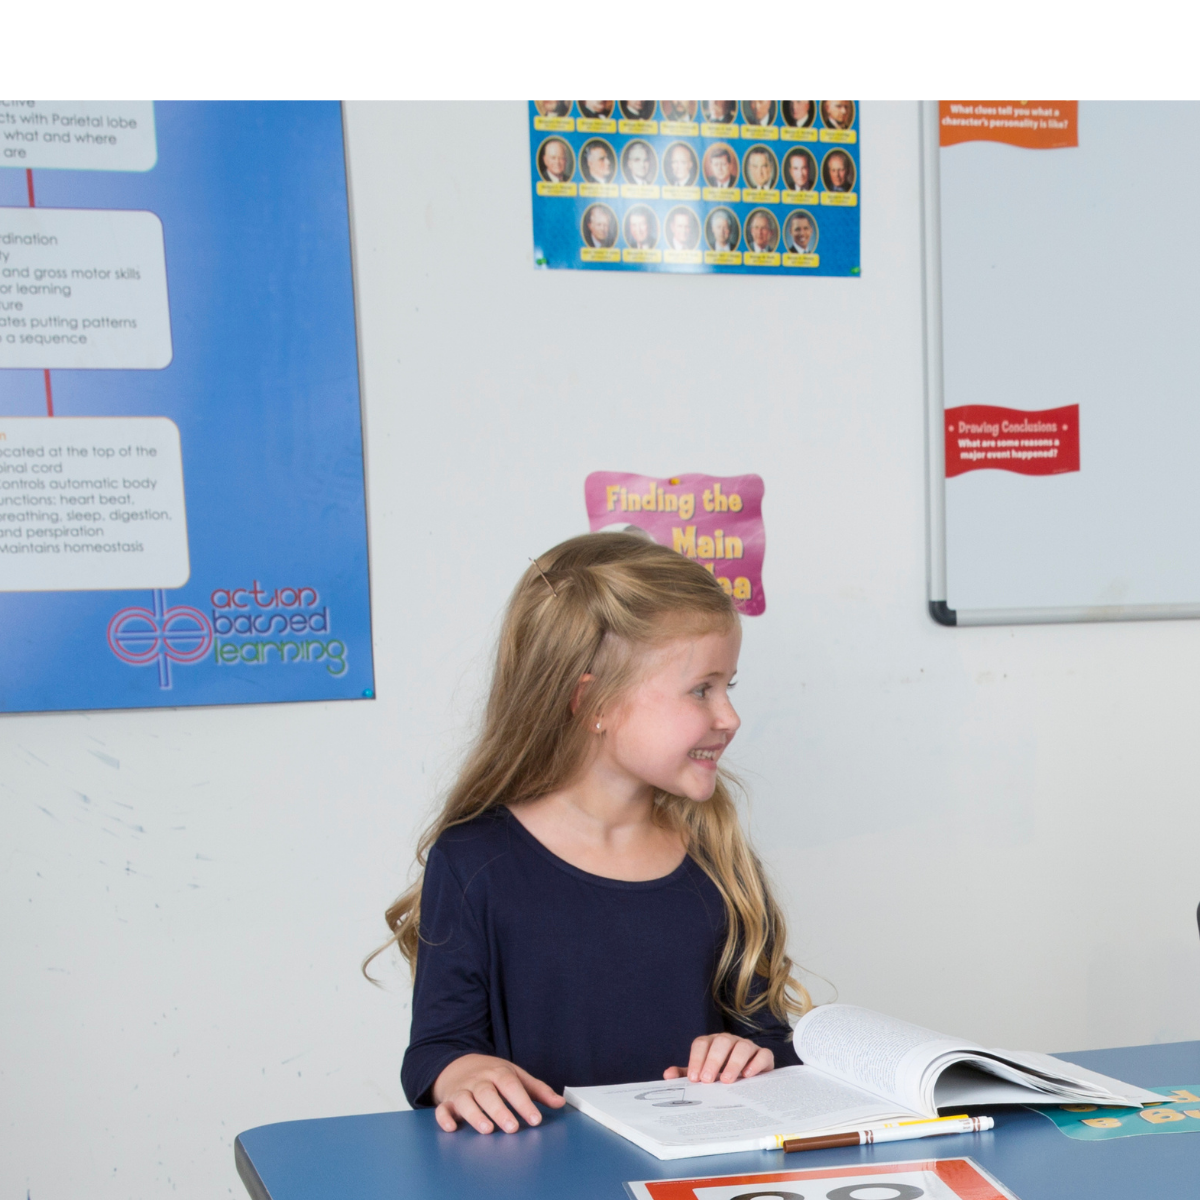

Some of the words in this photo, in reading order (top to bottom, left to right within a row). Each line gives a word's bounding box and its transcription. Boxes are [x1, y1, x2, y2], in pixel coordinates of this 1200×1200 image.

[950, 104, 973, 114] What
[1013, 107, 1030, 118] you
[1031, 107, 1053, 116] what
[20, 112, 48, 125] with
[52, 113, 104, 127] Parietal
[107, 116, 138, 129] lobe
[989, 118, 1038, 131] personality
[3, 130, 39, 142] what
[43, 132, 71, 143] and
[74, 133, 118, 145] where
[3, 148, 27, 159] are
[2, 267, 30, 278] and
[34, 268, 68, 281] gross
[71, 268, 112, 280] motor
[115, 267, 142, 280] skills
[16, 283, 72, 298] learning
[30, 316, 78, 330] putting
[82, 317, 138, 329] patterns
[6, 334, 16, 344] a
[20, 333, 88, 346] sequence
[958, 420, 999, 437] Drawing
[1001, 418, 1058, 434] Conclusions
[958, 439, 981, 448] What
[982, 440, 996, 448] are
[1020, 439, 1053, 447] reasons
[48, 446, 63, 457] at
[66, 445, 89, 457] the
[92, 445, 116, 459] top
[118, 445, 132, 457] of
[135, 445, 157, 457] the
[960, 450, 986, 461] major
[986, 450, 1011, 459] event
[1011, 448, 1059, 461] happened?
[31, 462, 63, 474] cord
[49, 477, 119, 490] automatic
[123, 477, 157, 491] body
[60, 494, 95, 506] heart
[606, 481, 696, 521] Finding
[702, 482, 744, 513] the
[109, 509, 172, 523] digestion,
[26, 525, 104, 540] perspiration
[63, 541, 144, 553] homeostasis
[672, 525, 744, 559] Main
[210, 579, 318, 609] action
[212, 606, 328, 635] based
[214, 637, 346, 675] learning
